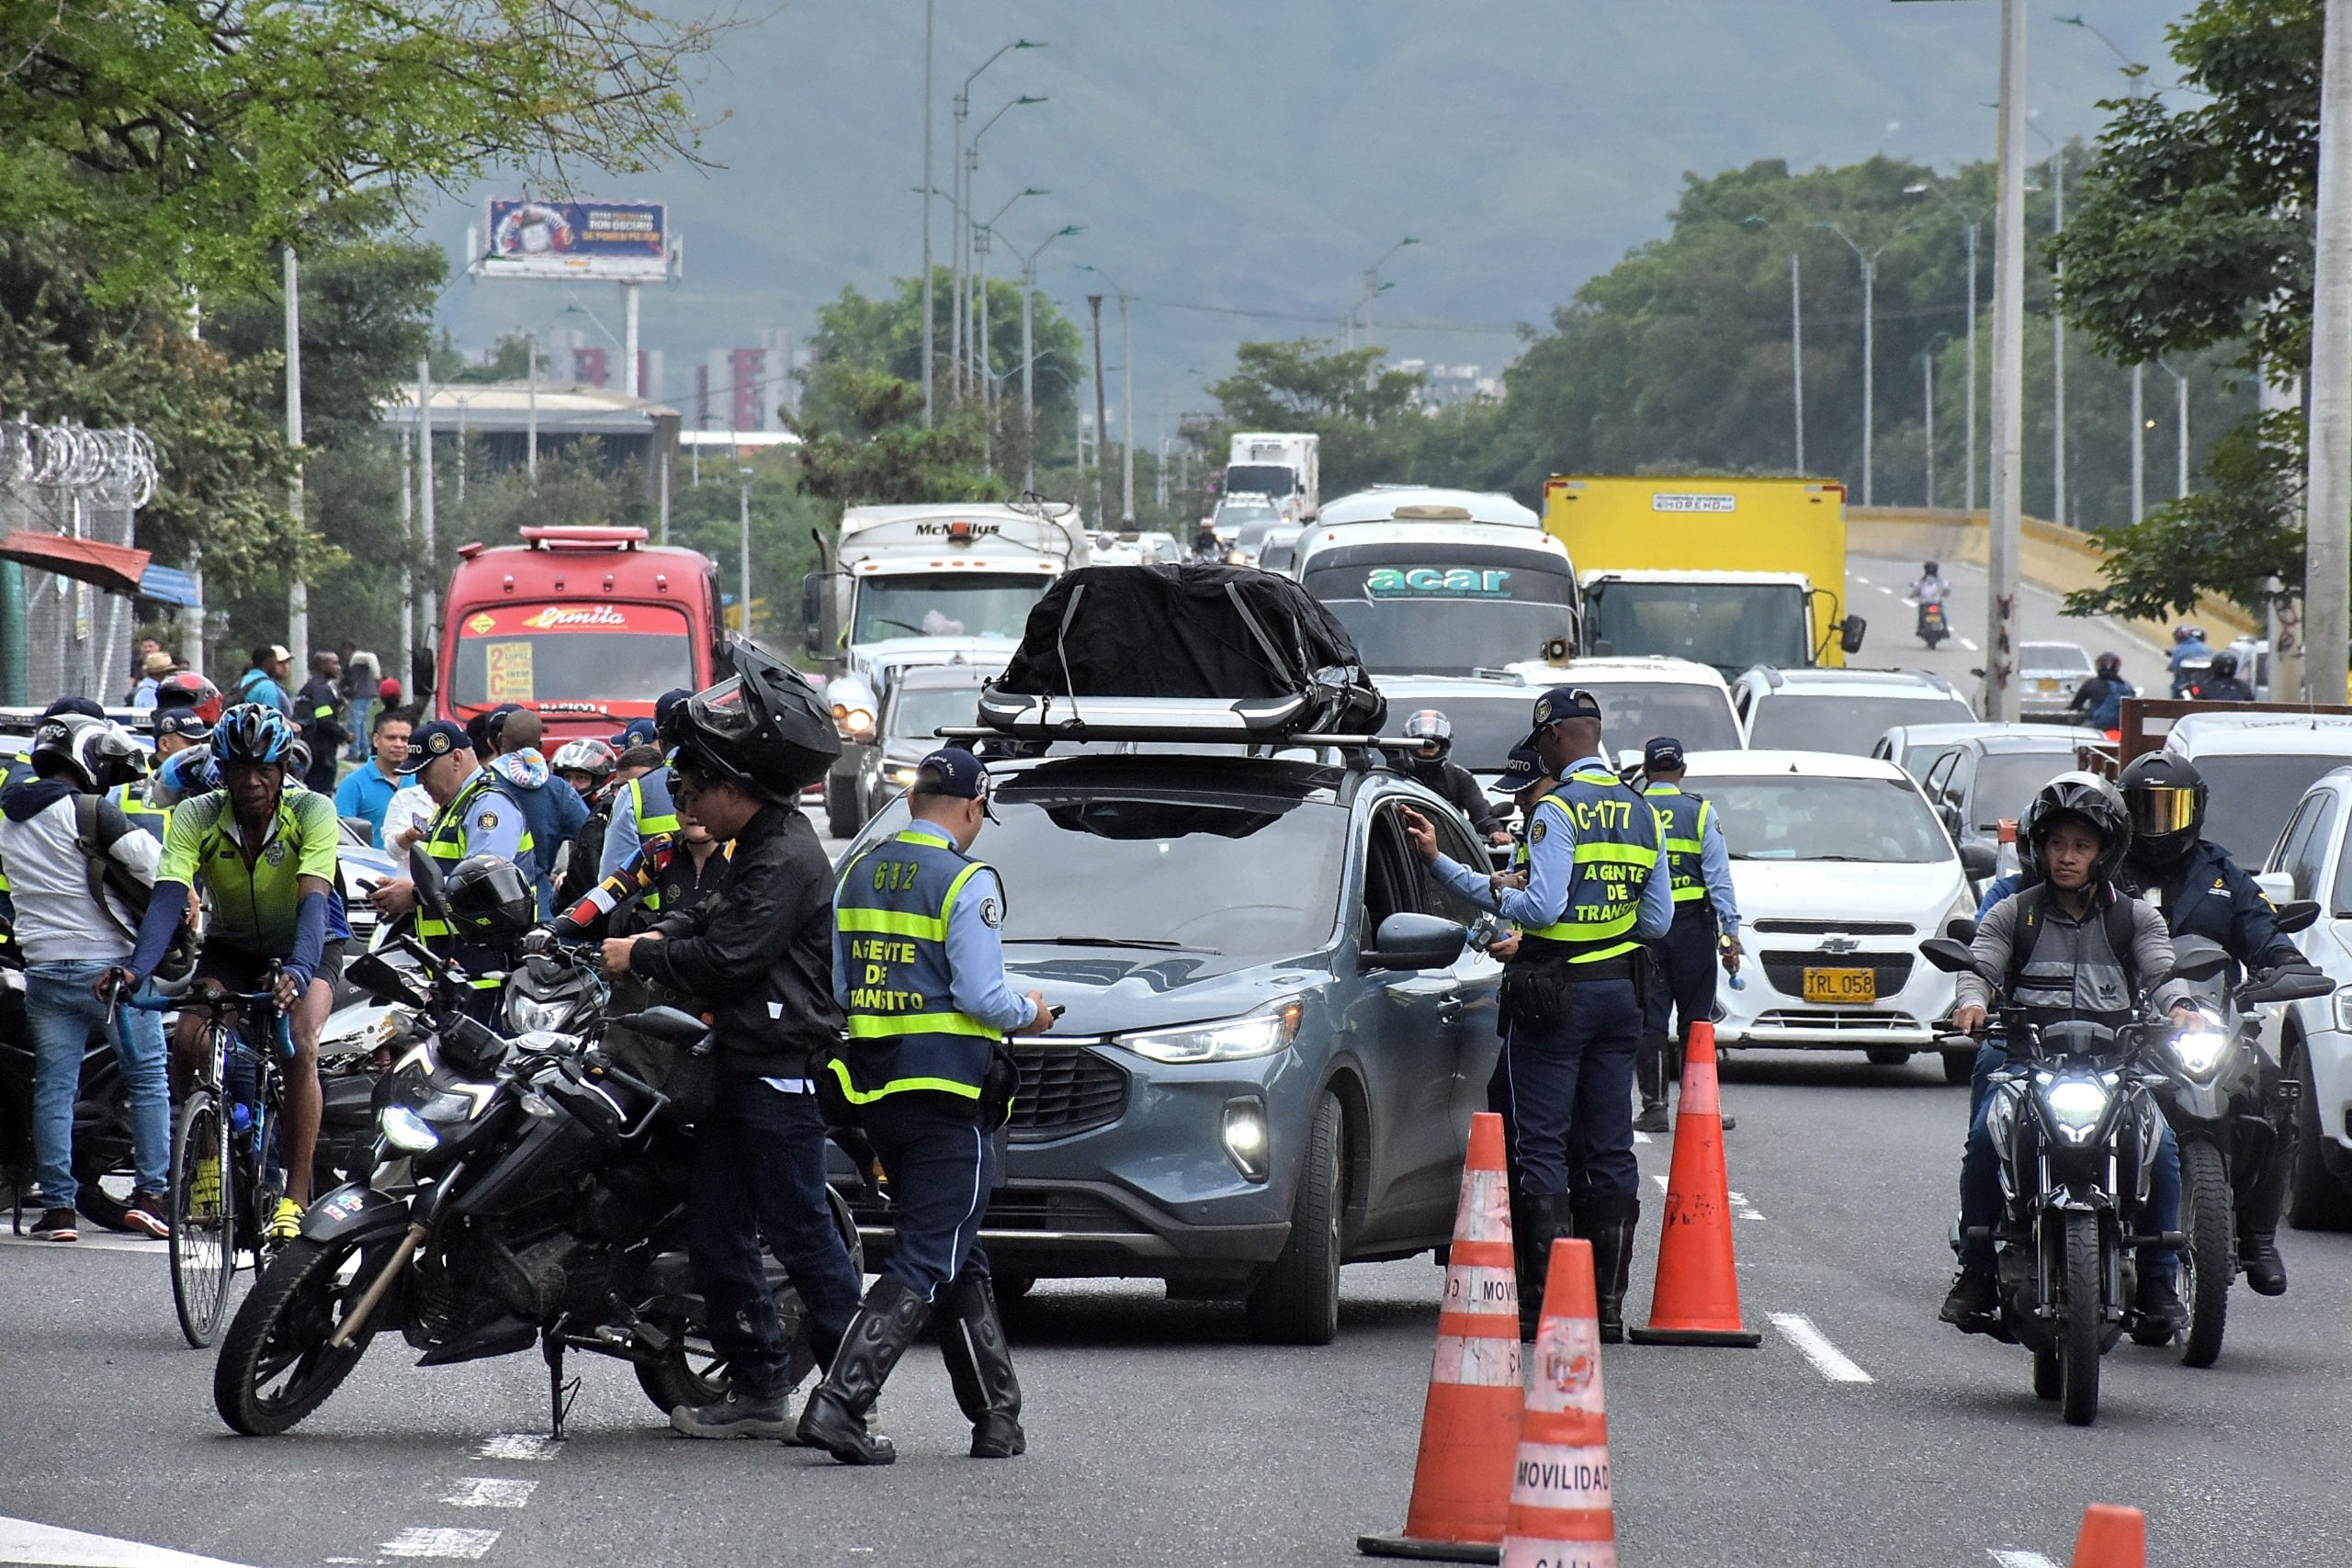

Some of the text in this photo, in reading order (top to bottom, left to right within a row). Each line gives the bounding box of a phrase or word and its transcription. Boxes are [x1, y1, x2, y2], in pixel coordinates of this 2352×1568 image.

[590, 220, 653, 231] RON OSCURO
[916, 523, 1000, 536] McNilus
[1367, 569, 1511, 592] acar
[538, 605, 626, 628] Ermita
[491, 648, 504, 671] 2
[491, 673, 505, 695] C
[1577, 800, 1632, 830] C-177
[1607, 885, 1627, 901] DE
[865, 964, 887, 986] DE
[1808, 976, 1872, 993] IRL 058
[1517, 1461, 1610, 1491] MOVILIDAD
